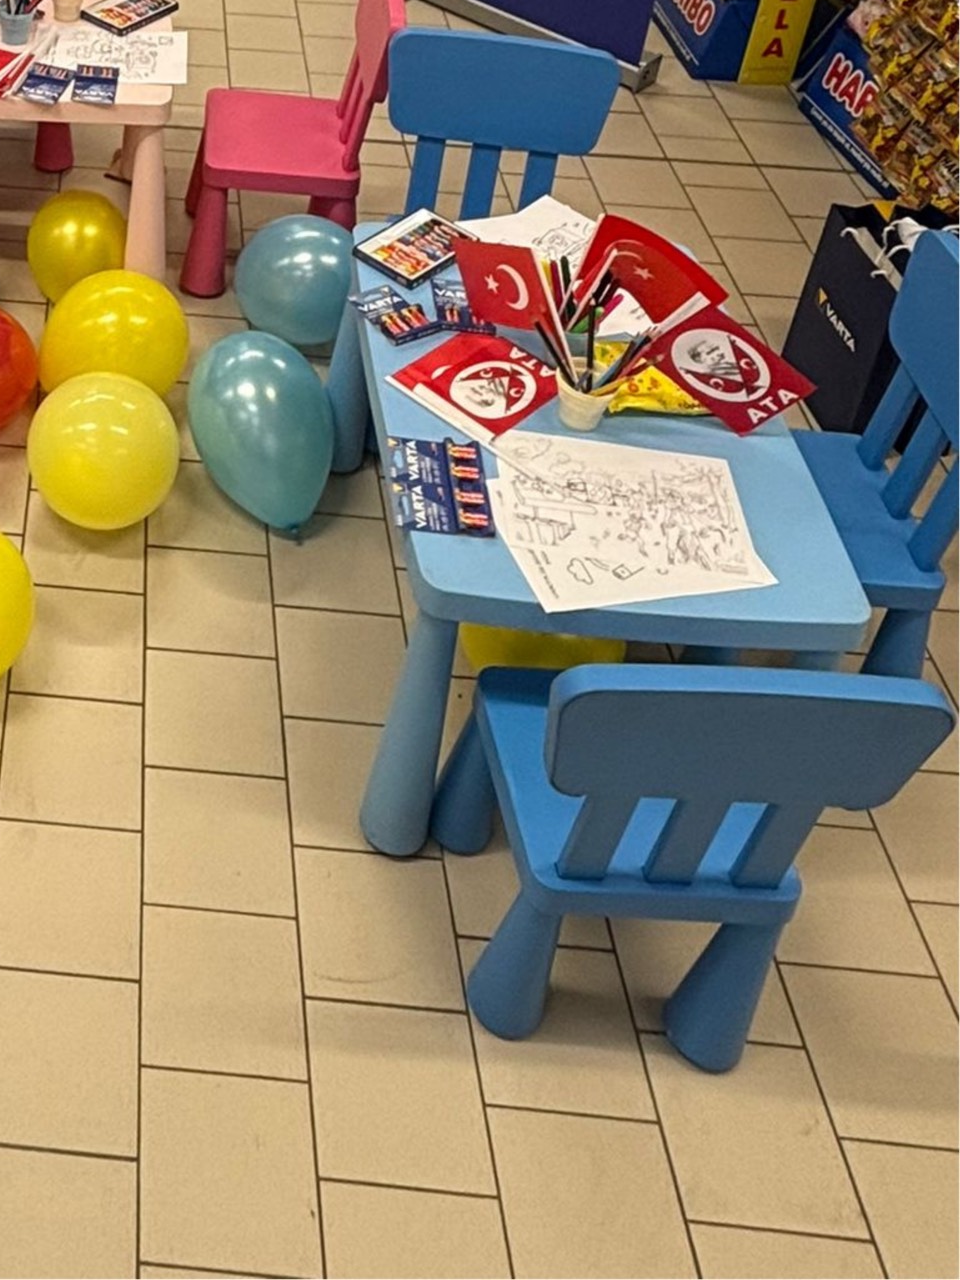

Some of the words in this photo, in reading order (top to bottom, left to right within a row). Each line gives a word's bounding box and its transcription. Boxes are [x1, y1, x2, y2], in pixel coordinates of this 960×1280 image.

[822, 52, 880, 118] HAR
[357, 295, 403, 312] VARTA
[434, 288, 466, 298] VAR
[826, 303, 856, 353] VARTA
[509, 346, 557, 377] ATA
[747, 389, 800, 424] ATA
[405, 440, 420, 480] VARTA
[411, 485, 427, 528] VARTA
